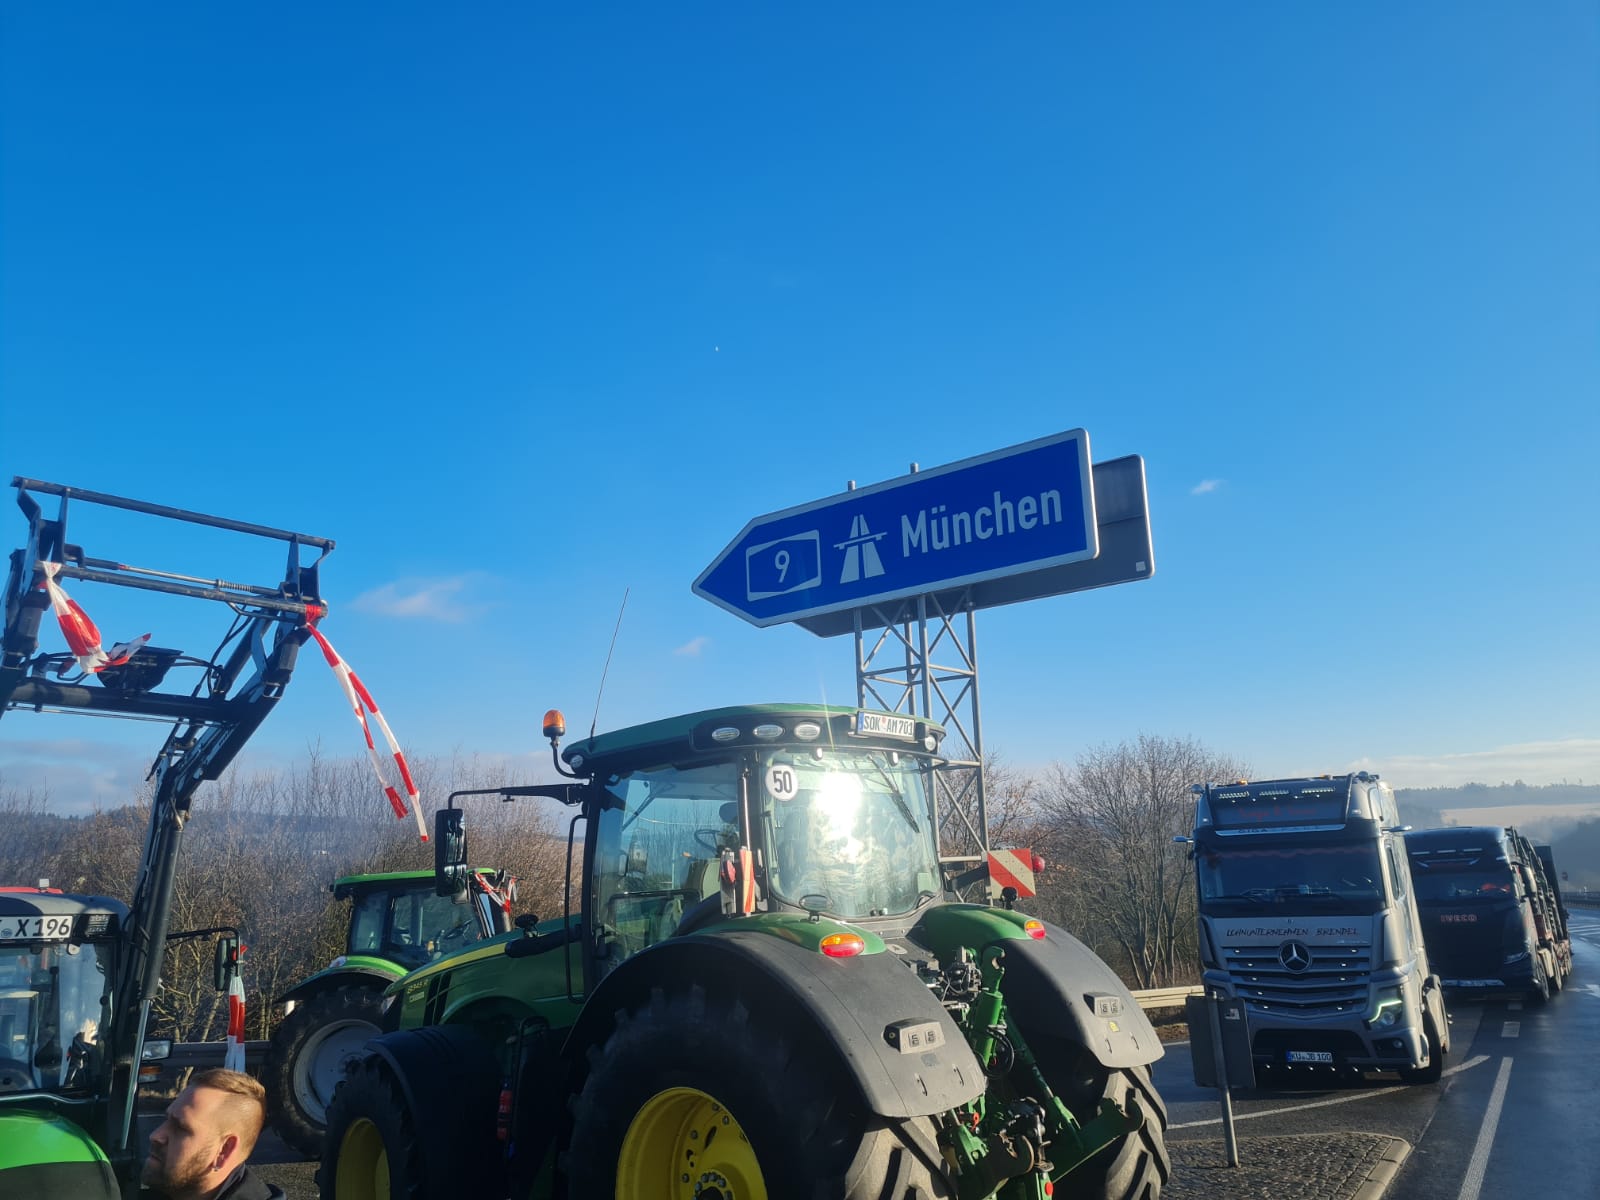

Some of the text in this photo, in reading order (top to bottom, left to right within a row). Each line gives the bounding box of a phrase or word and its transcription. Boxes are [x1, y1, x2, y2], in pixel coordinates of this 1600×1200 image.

[900, 488, 1063, 558] München
[774, 549, 790, 584] 9
[863, 715, 880, 732] SOK
[886, 718, 898, 733] AM
[772, 770, 793, 794] 50
[15, 918, 70, 937] X 196
[1440, 914, 1478, 922] IVECO
